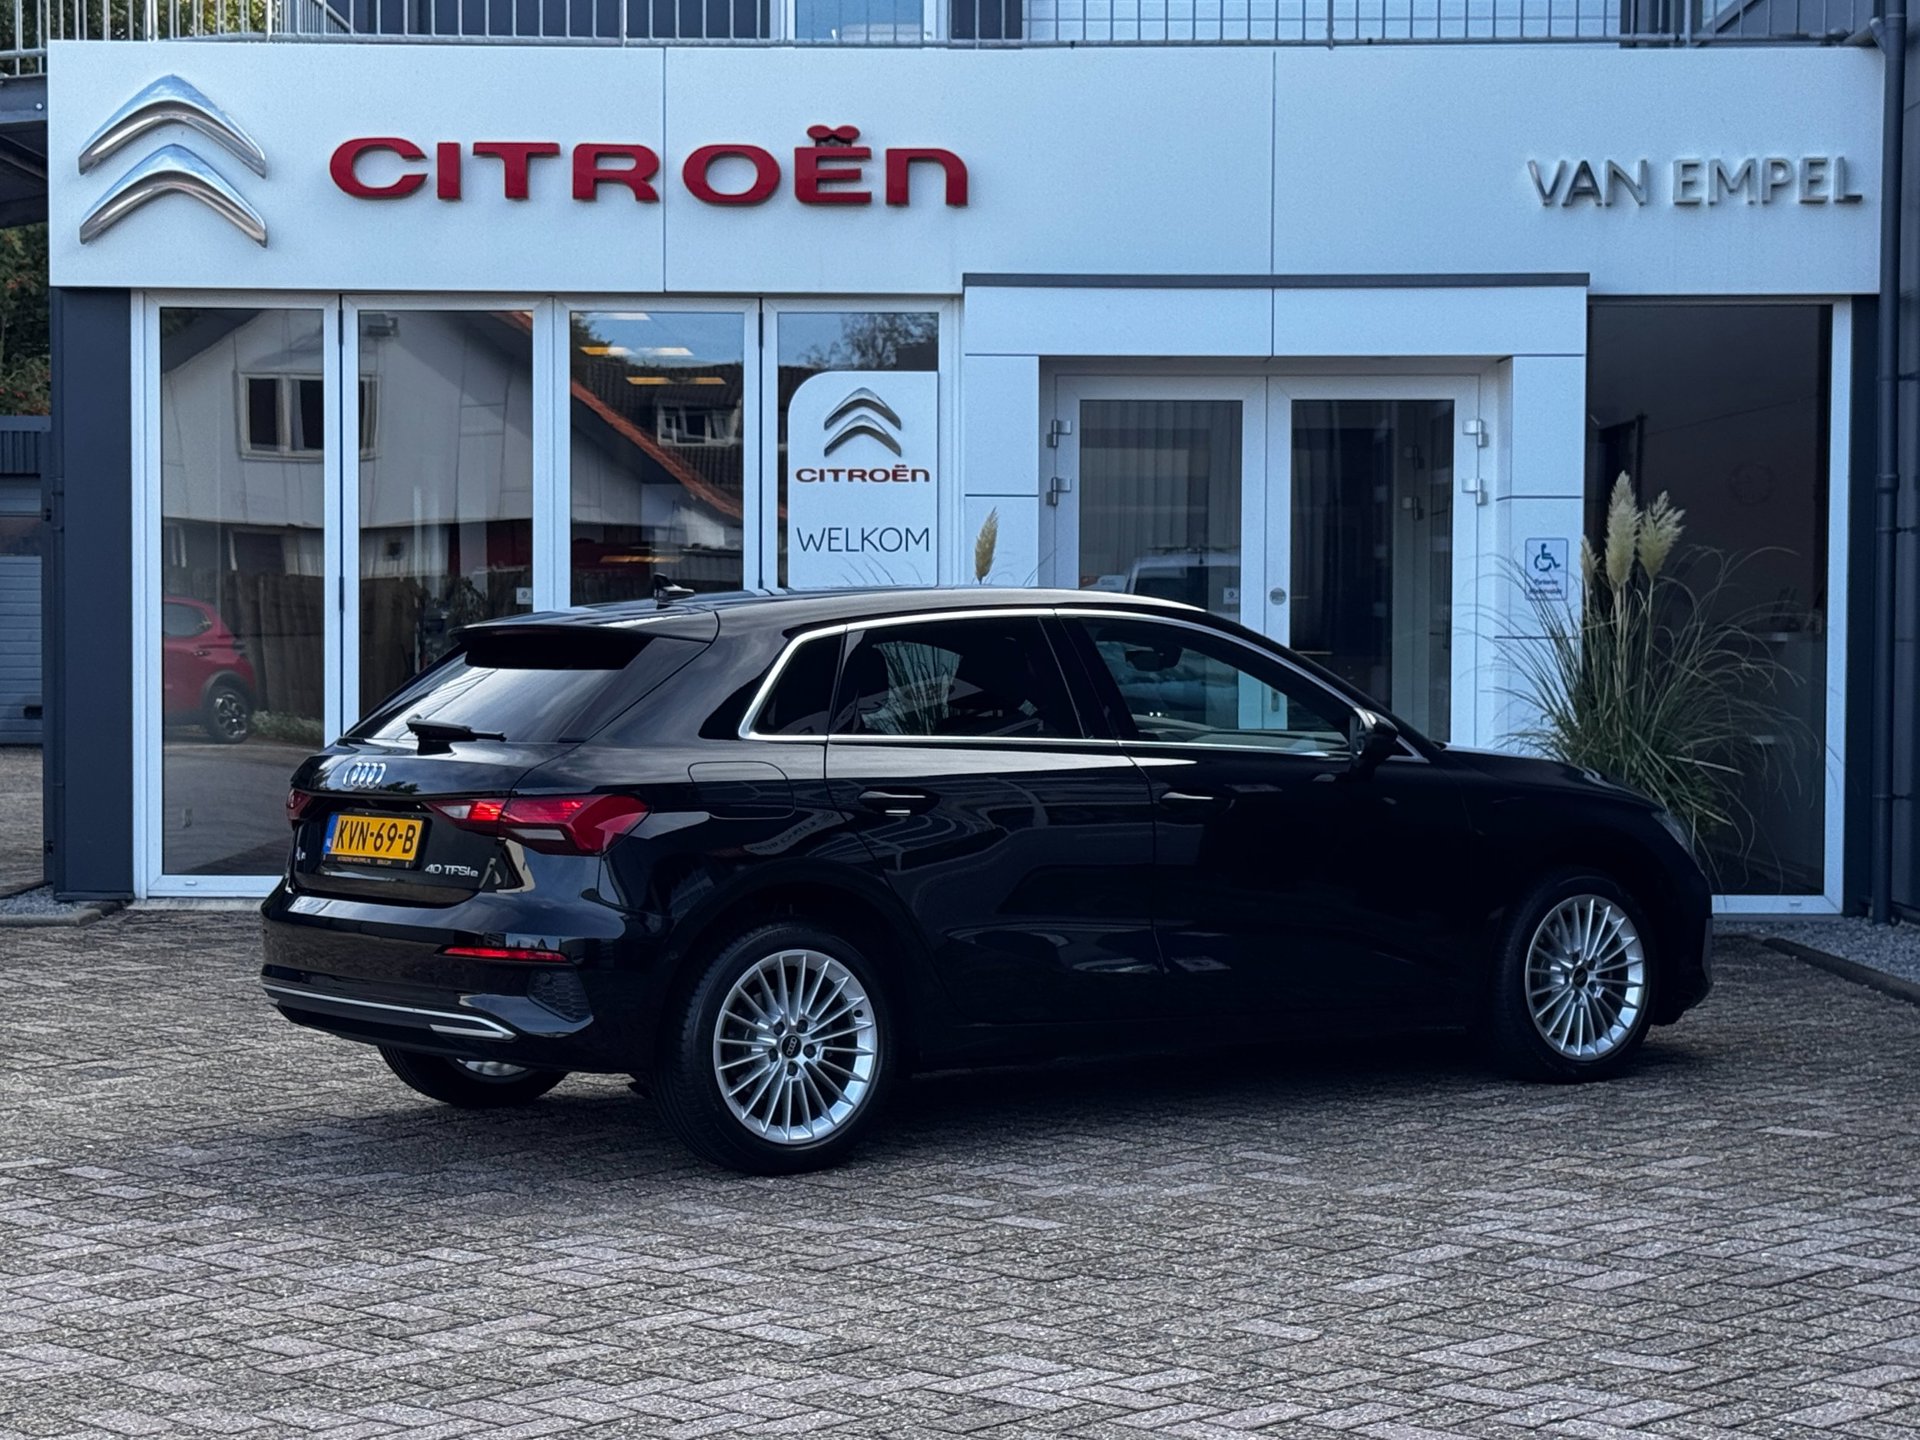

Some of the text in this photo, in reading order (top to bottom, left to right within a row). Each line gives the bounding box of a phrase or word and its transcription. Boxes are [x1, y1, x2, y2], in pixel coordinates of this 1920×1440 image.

[1527, 156, 1863, 207] VAN EMPEL
[796, 527, 930, 552] WELKOM
[336, 820, 416, 854] KVN-69-B
[425, 864, 442, 874] 40
